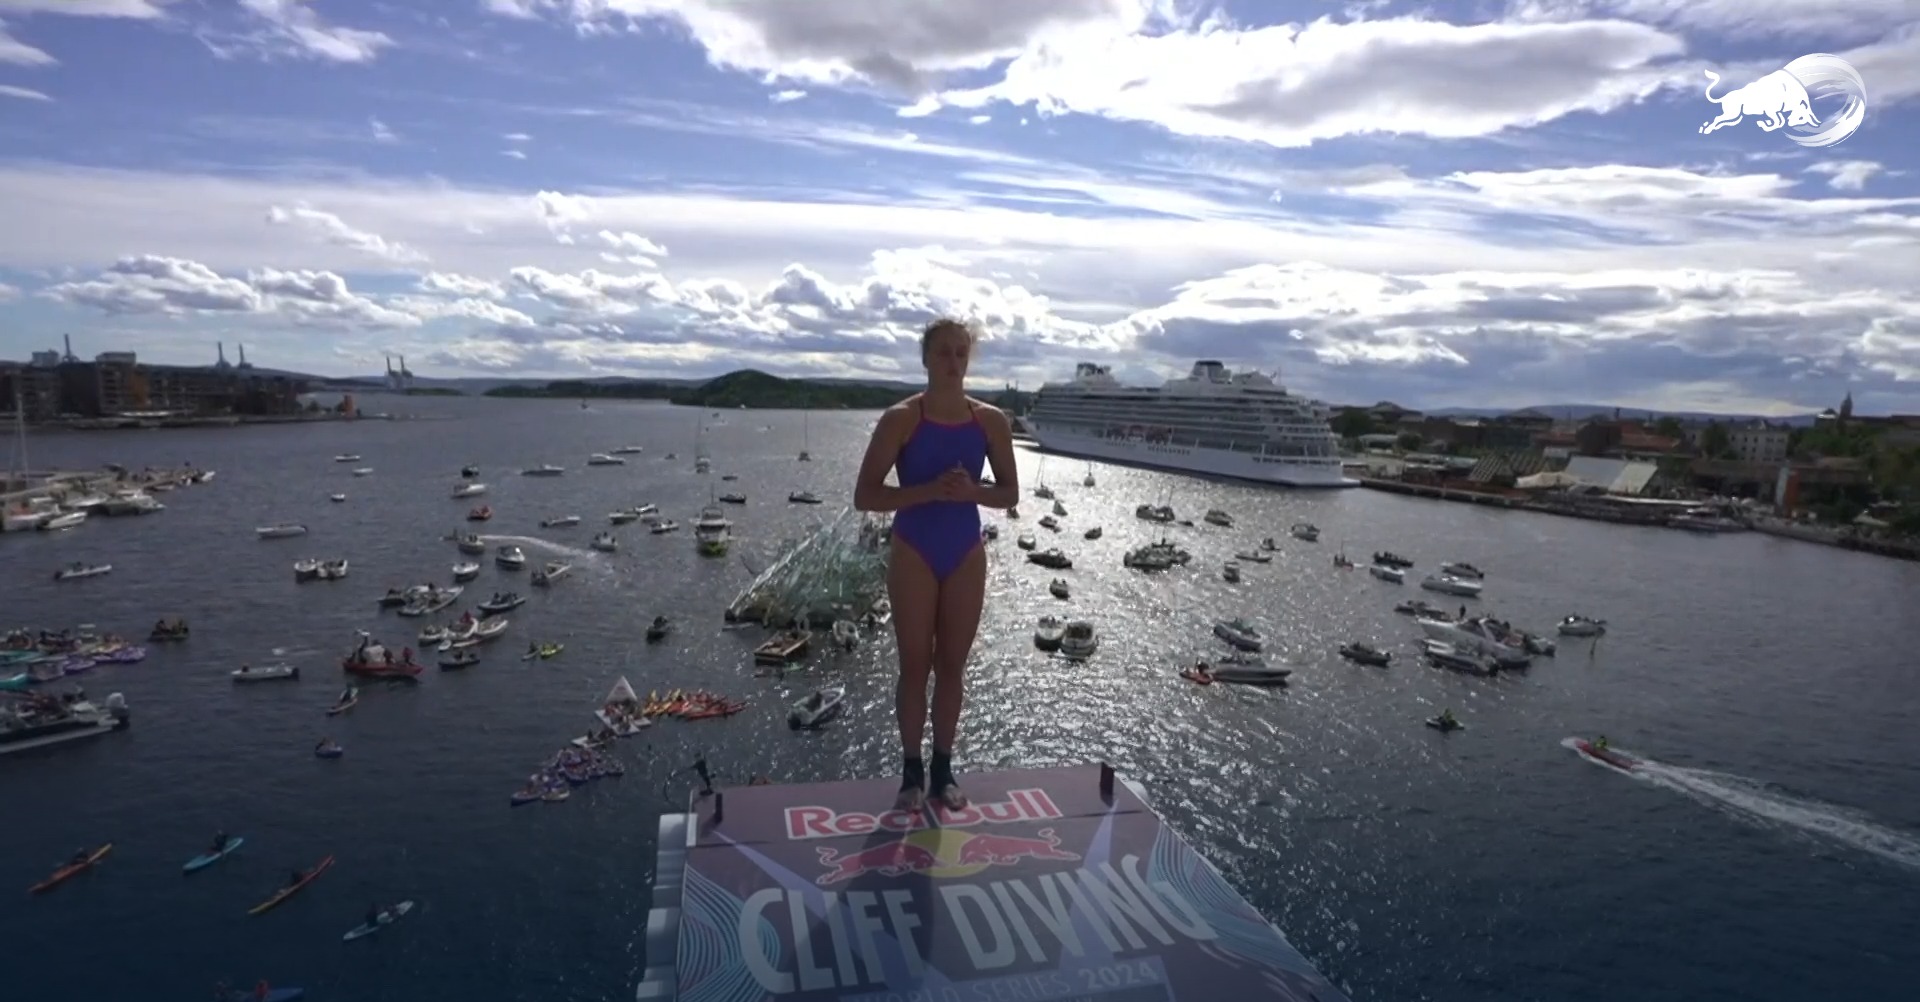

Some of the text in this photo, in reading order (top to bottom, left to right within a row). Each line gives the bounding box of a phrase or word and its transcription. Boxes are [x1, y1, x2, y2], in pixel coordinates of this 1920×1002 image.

[784, 788, 1063, 840] Red Bull
[738, 854, 1218, 994] CLIFF DIVING
[853, 961, 1158, 1002] ORLD SERIES 2024
